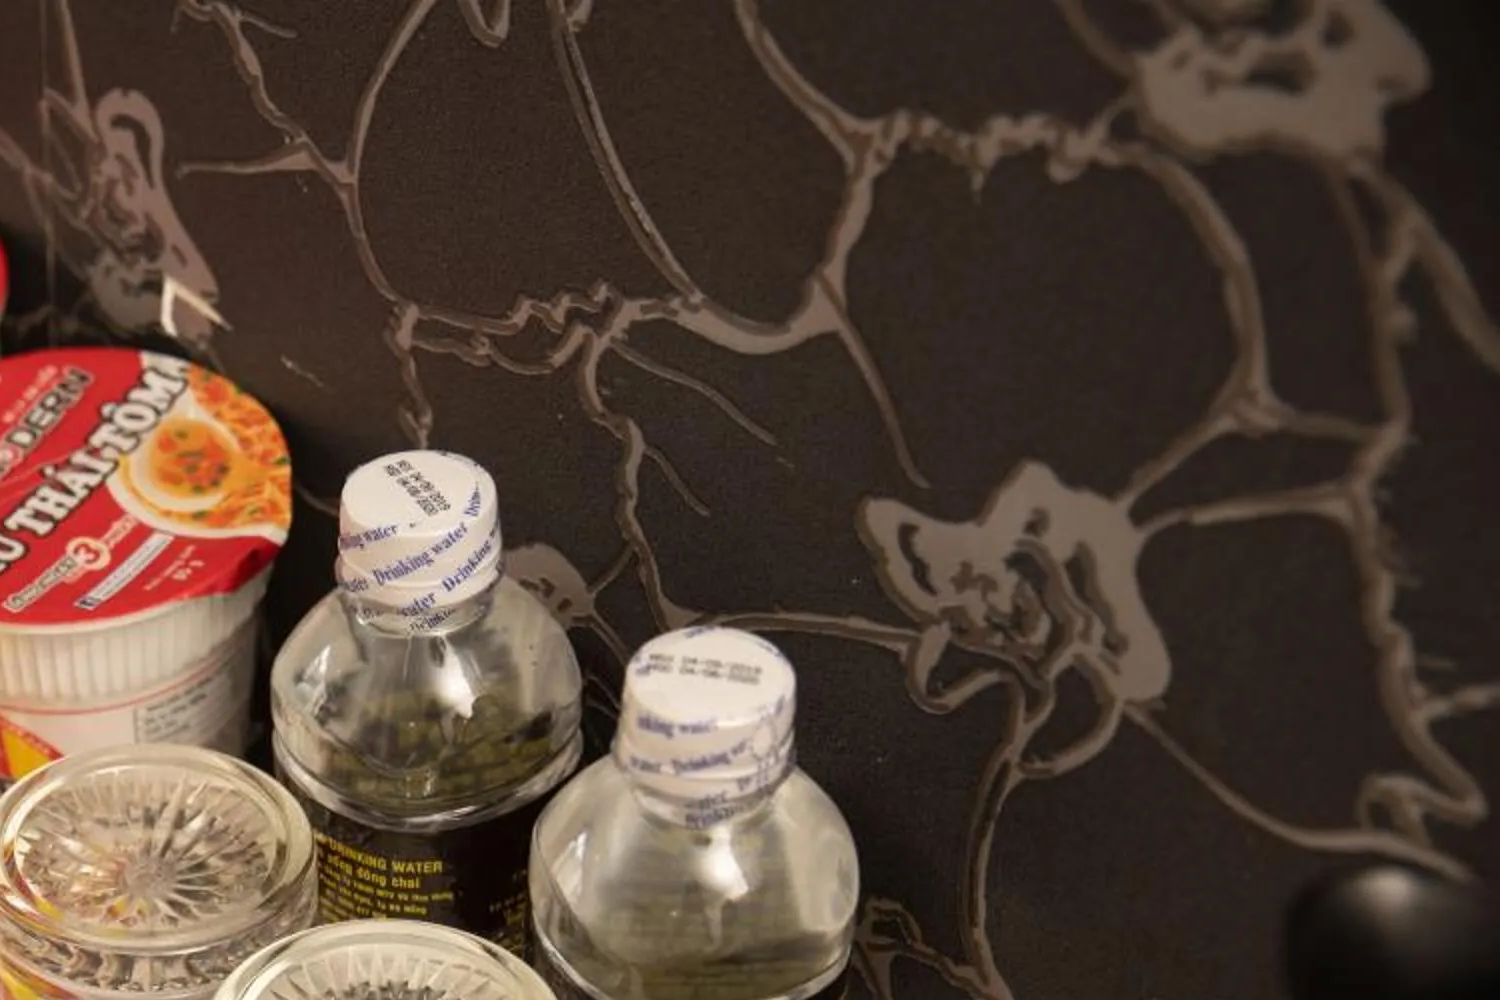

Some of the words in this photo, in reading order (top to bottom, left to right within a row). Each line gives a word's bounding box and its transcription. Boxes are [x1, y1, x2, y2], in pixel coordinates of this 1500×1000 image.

[371, 549, 435, 587] Drinking
[430, 521, 469, 554] water
[391, 860, 444, 875] WATER
